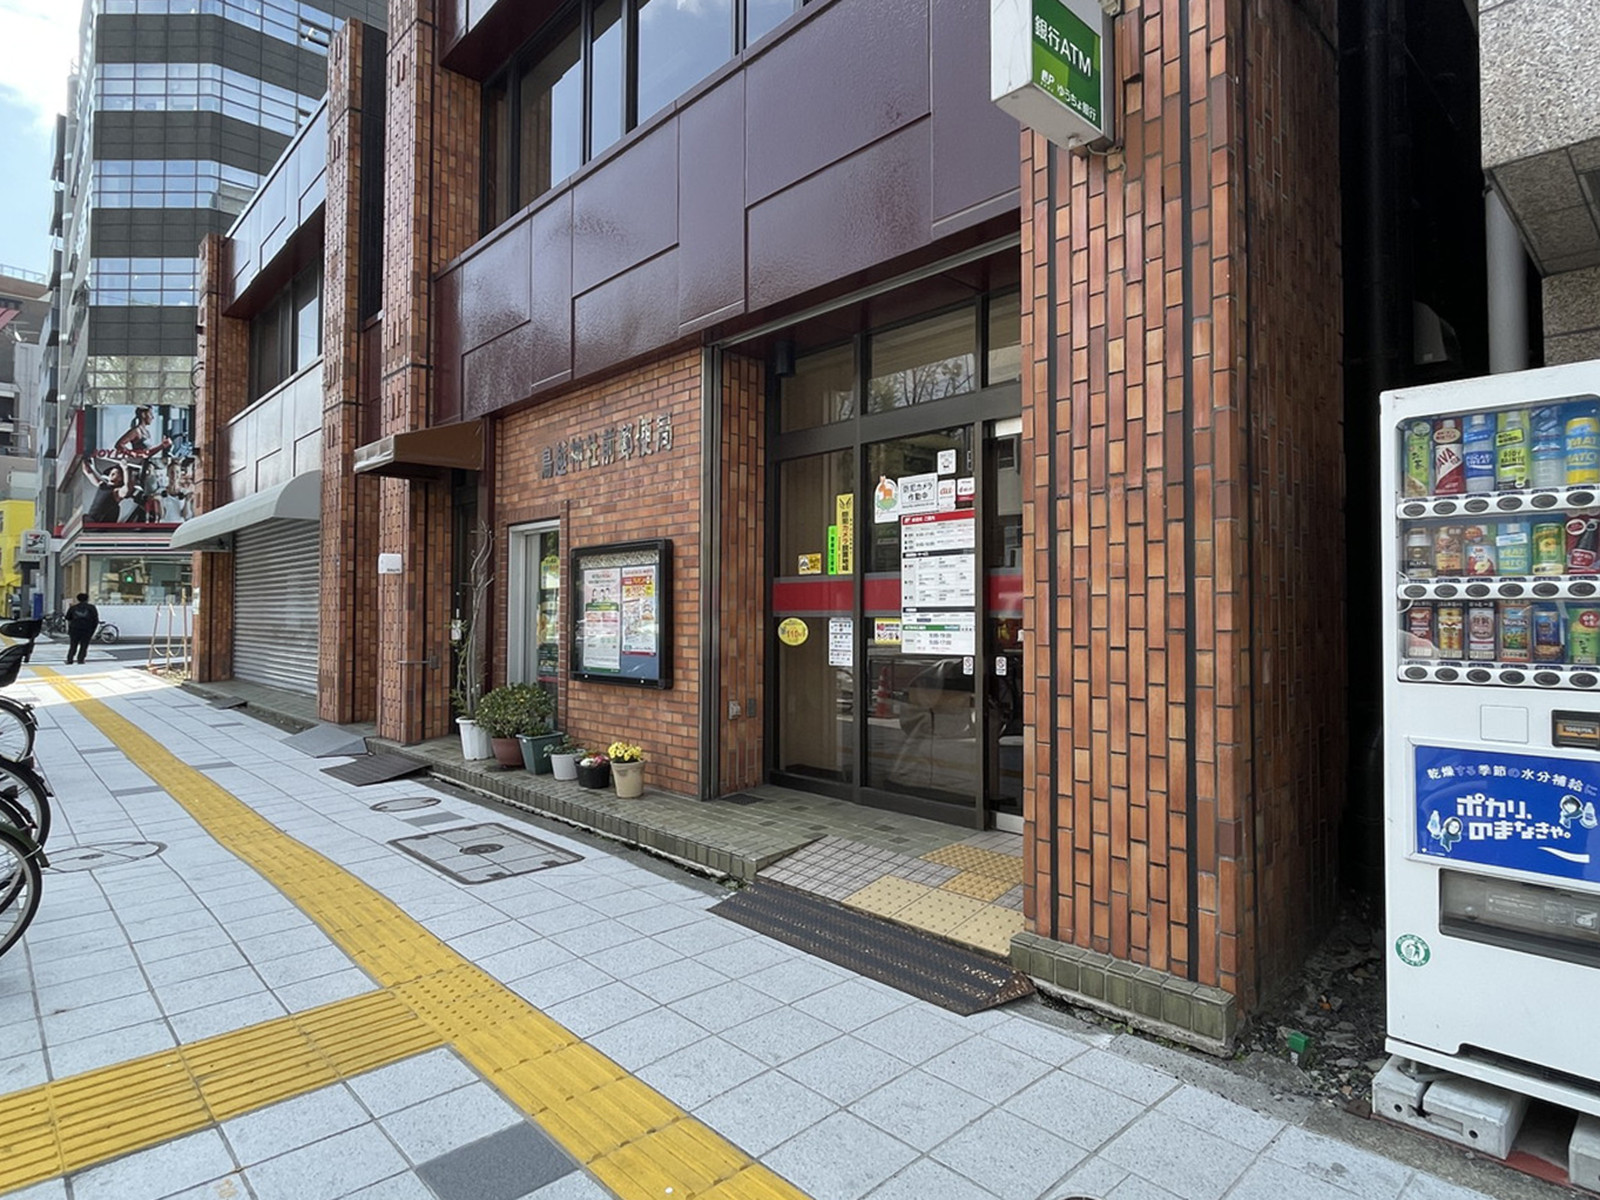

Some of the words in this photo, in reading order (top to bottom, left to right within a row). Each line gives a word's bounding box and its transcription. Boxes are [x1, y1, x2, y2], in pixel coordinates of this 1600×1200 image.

[1034, 14, 1091, 77] 銀行ATM
[1057, 84, 1097, 121] ゆうちょ銀行
[541, 411, 674, 479] 鳥越神社前郵便局
[1426, 764, 1599, 797] 乾燥する季節の水分補給に
